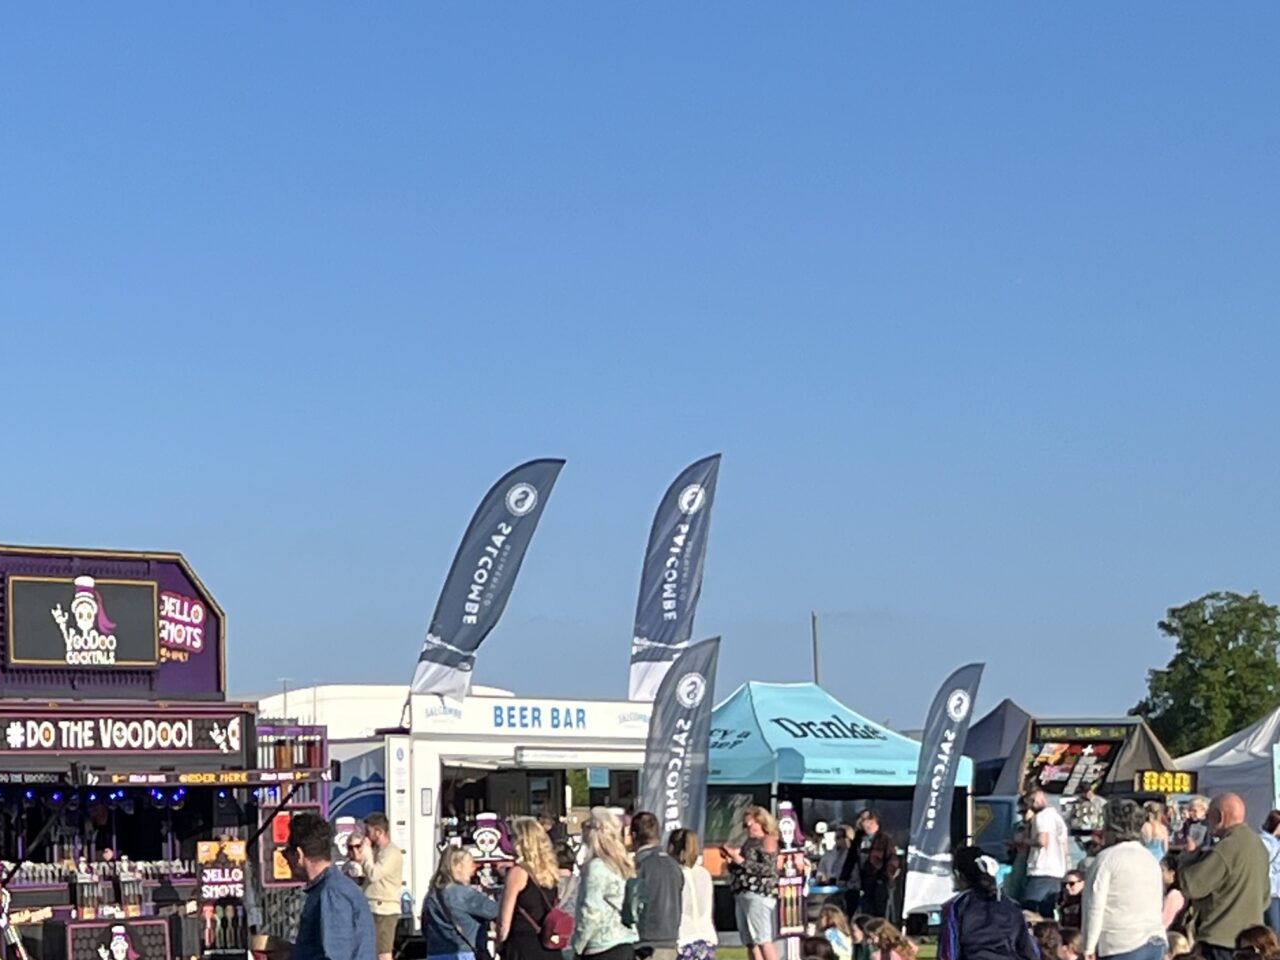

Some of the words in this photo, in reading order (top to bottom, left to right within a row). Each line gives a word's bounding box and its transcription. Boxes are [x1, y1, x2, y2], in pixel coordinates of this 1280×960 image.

[160, 595, 204, 624] JELLO
[493, 706, 542, 728] BEER
[550, 707, 587, 729] BAR
[6, 720, 55, 748] #DO
[58, 720, 94, 748] THE
[99, 718, 193, 749] VOODOO!
[1143, 771, 1192, 792] BAR
[202, 868, 243, 882] JELLO
[202, 883, 244, 899] SHOTS
